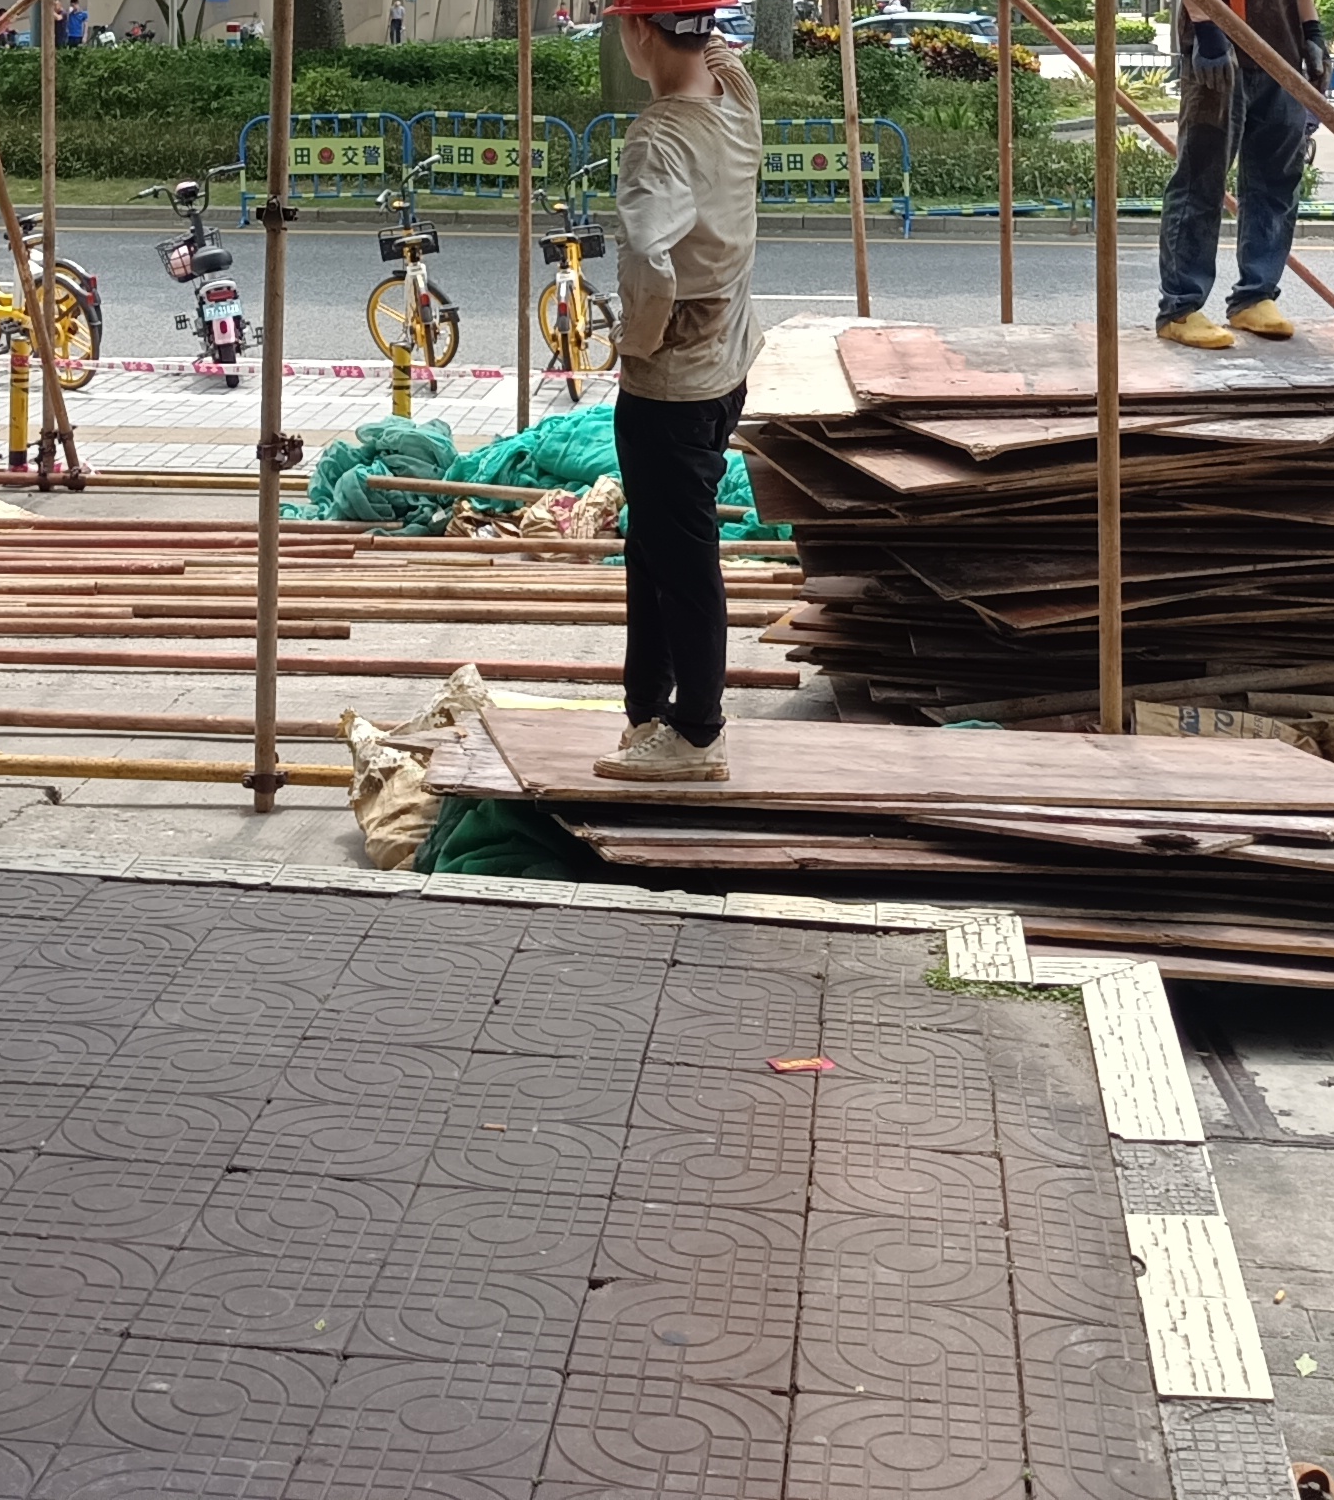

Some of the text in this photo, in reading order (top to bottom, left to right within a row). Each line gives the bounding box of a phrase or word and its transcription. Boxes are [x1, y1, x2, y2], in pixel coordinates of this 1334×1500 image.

[341, 145, 381, 166] 交警
[436, 144, 545, 169] 福田 交警
[763, 152, 804, 173] 福田
